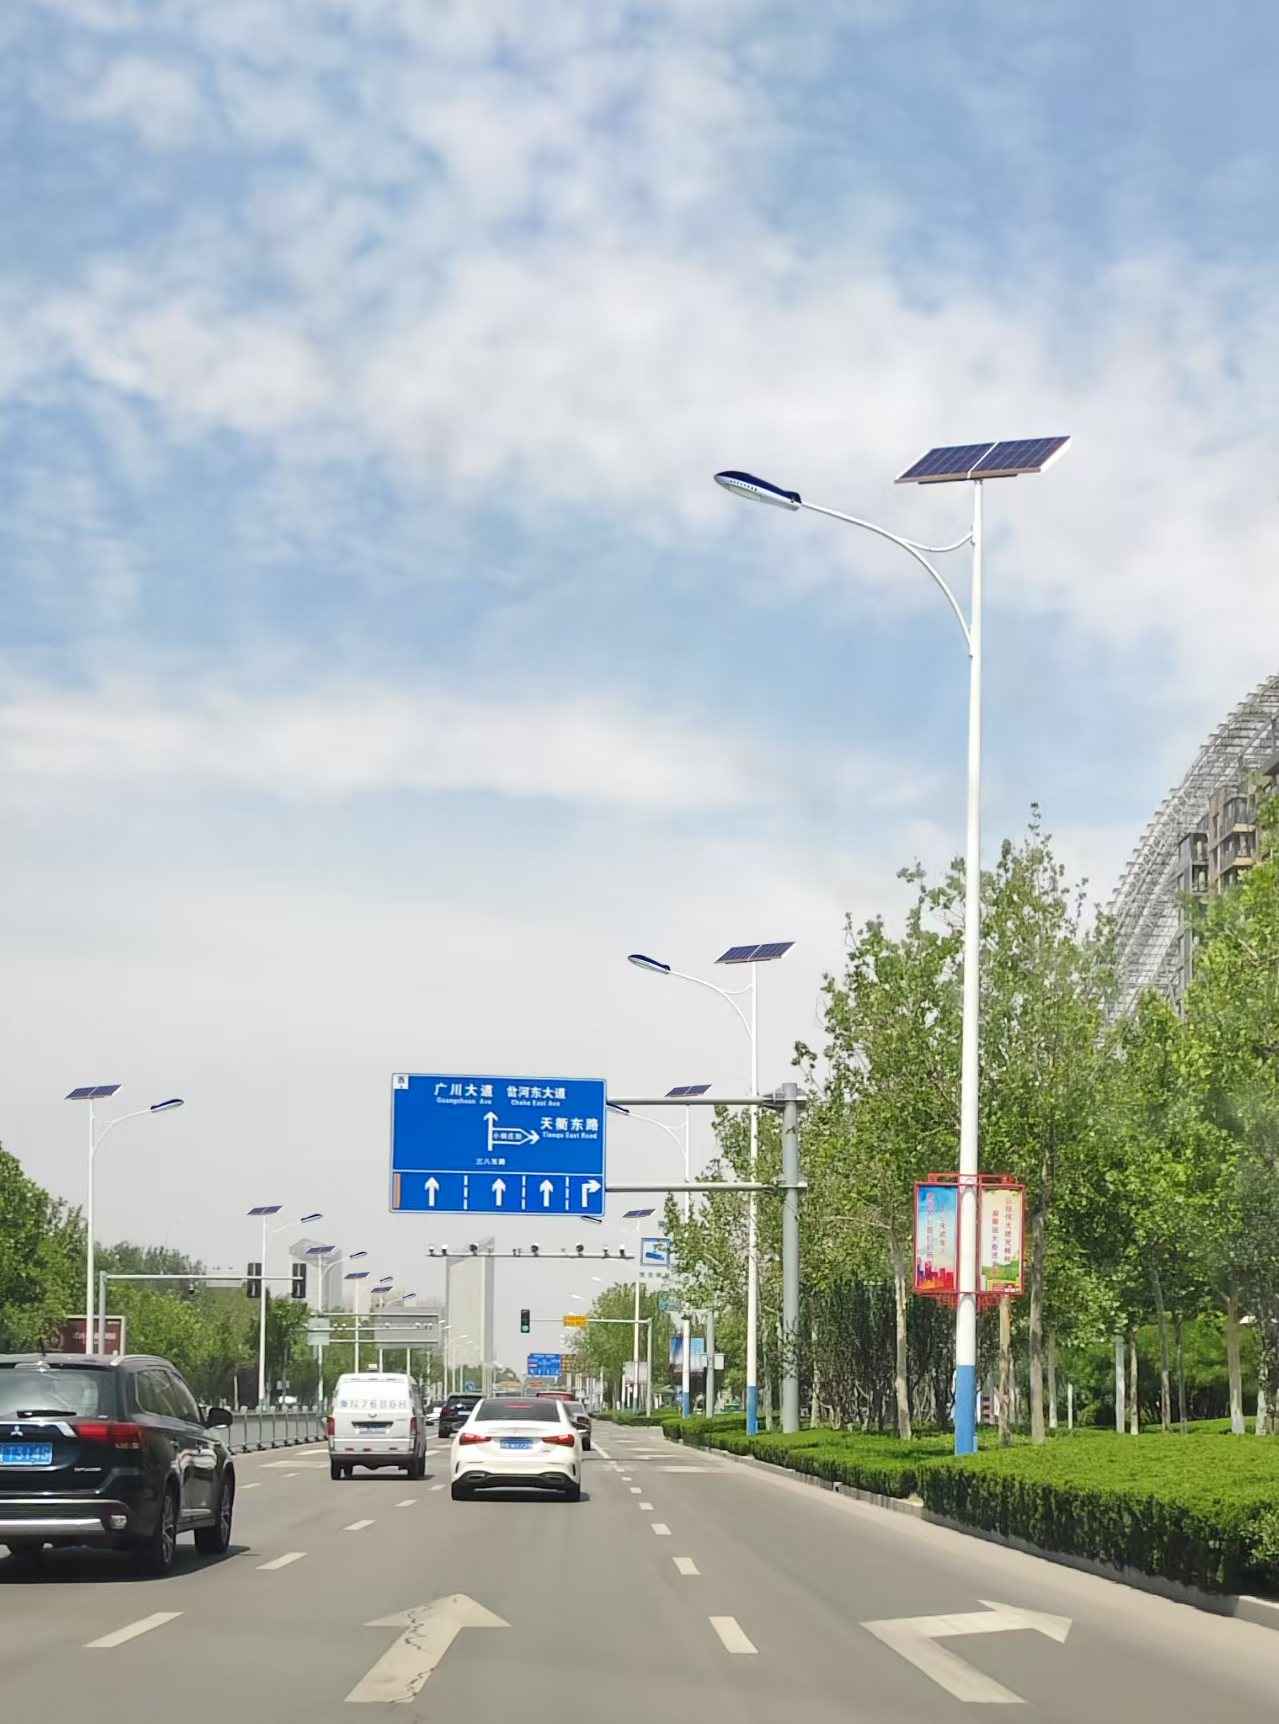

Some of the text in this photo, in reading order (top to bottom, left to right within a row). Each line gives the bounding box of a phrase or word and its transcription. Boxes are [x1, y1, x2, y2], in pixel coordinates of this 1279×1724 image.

[433, 1082, 494, 1098] 广川大道
[565, 1131, 579, 1139] East
[581, 1132, 597, 1140] Road
